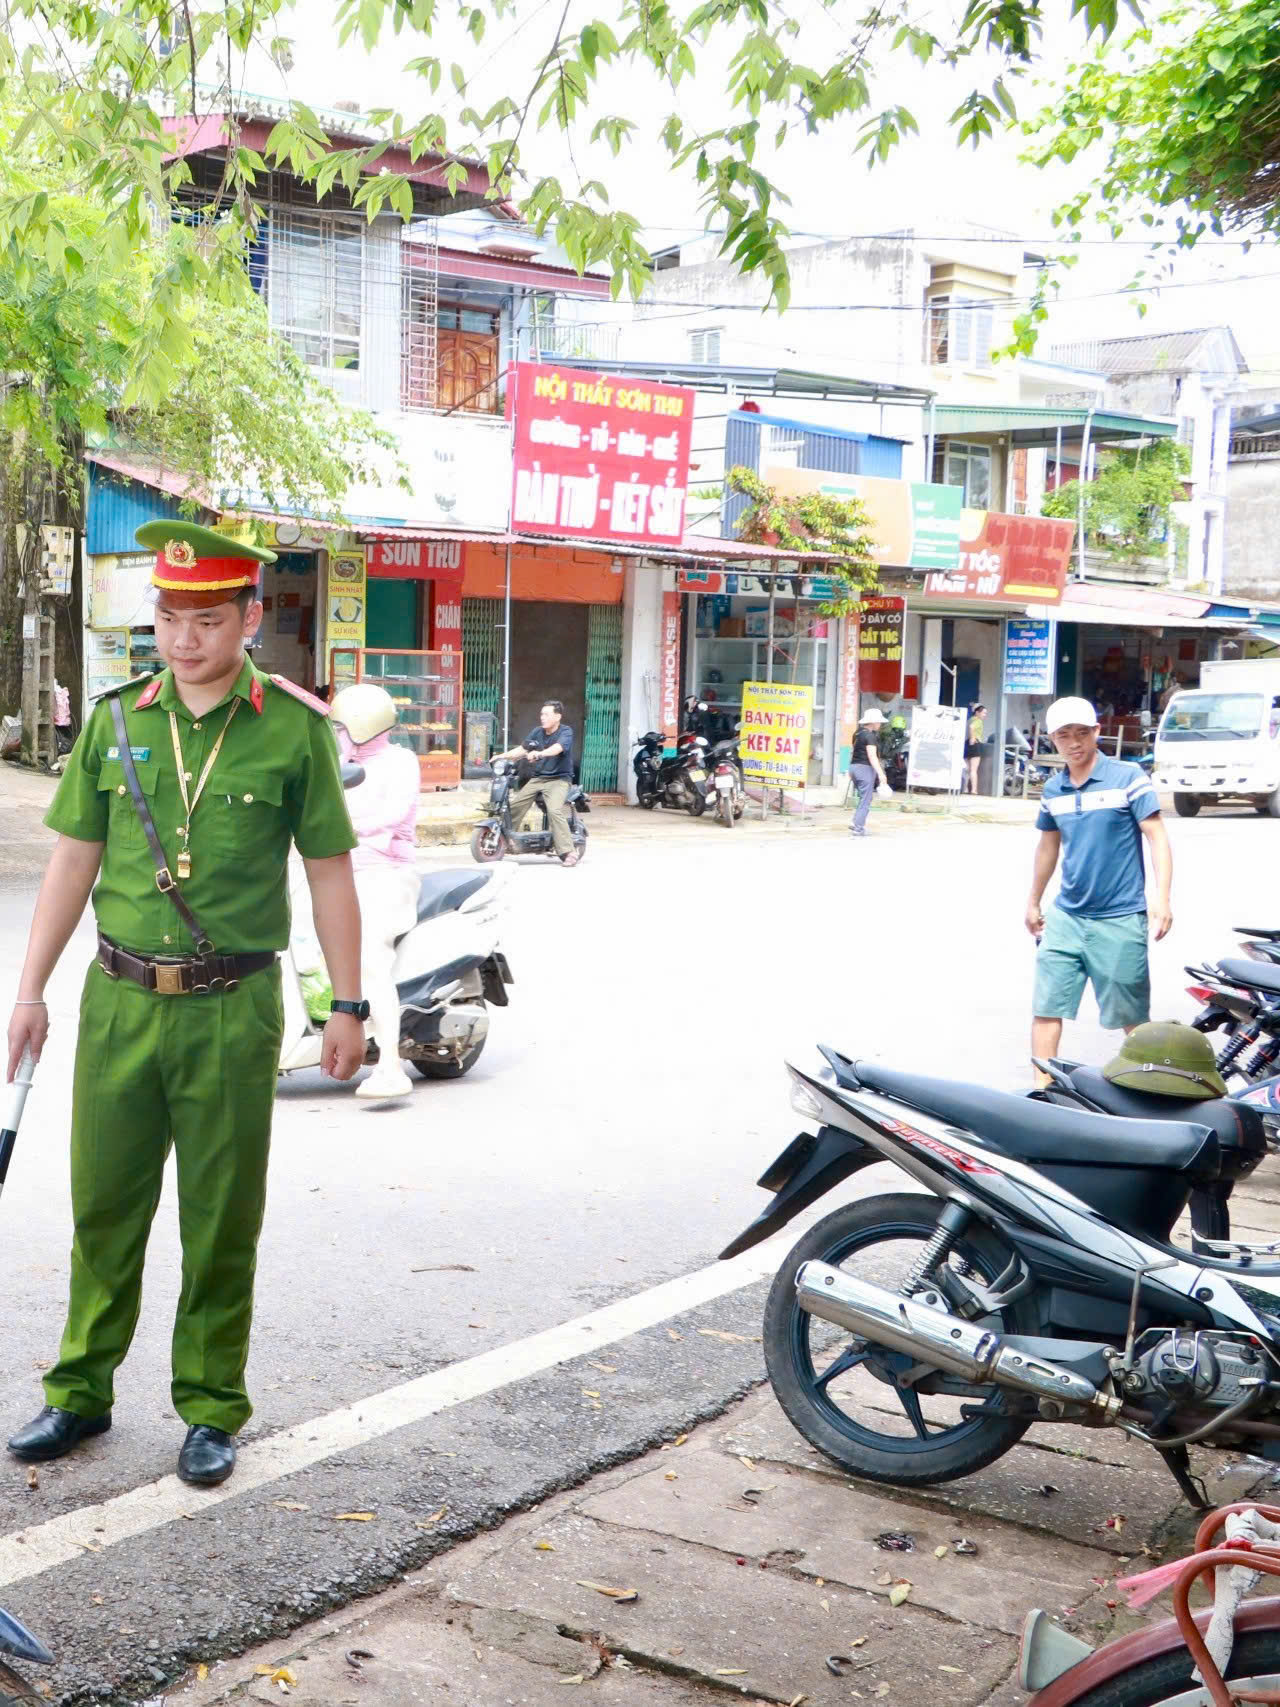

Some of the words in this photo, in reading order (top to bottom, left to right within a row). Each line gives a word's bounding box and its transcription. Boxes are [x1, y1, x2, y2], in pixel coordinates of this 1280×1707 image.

[534, 373, 568, 405] NỘI
[573, 375, 614, 407] THẤT
[616, 388, 652, 412] SƠN
[654, 394, 684, 417] THU
